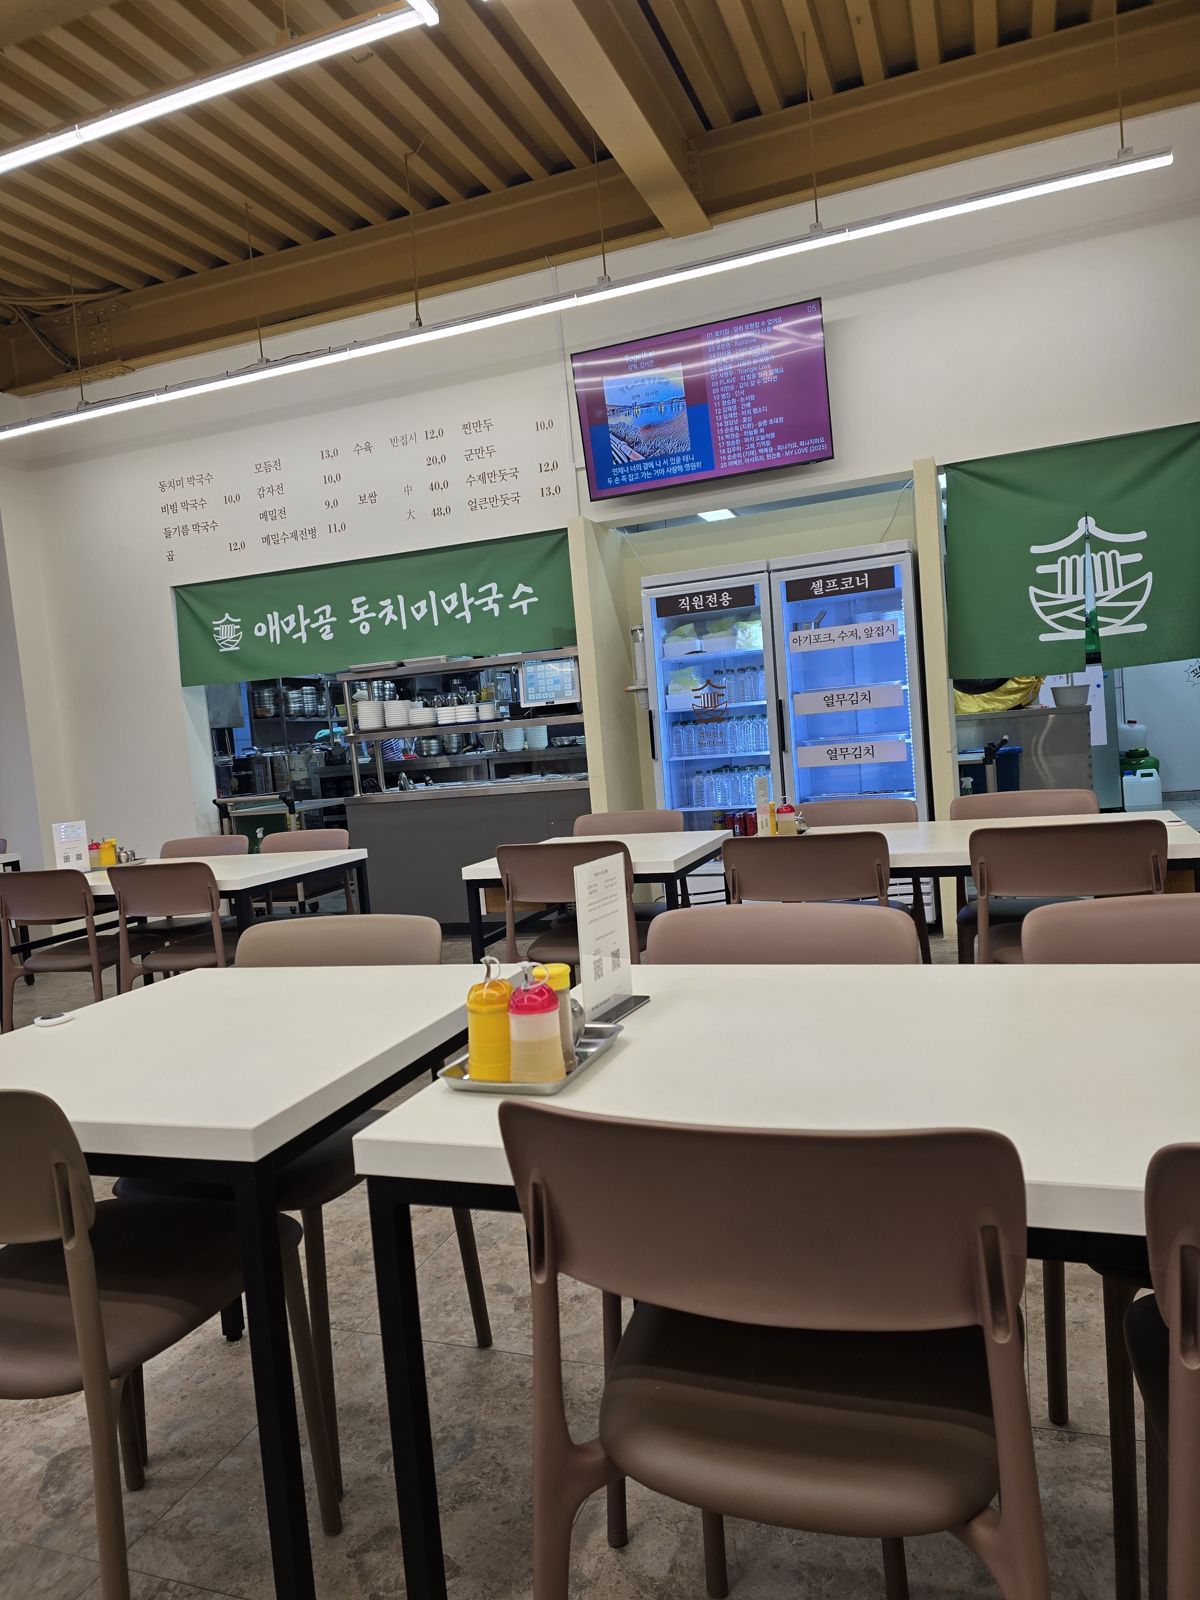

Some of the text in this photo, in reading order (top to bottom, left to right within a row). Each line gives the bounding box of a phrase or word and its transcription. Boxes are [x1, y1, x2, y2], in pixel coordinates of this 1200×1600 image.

[738, 366, 757, 375] Triangle
[720, 377, 736, 386] PLAVE
[462, 419, 493, 435] 찐만두
[353, 441, 373, 455] 수육
[390, 432, 417, 447] 반접시
[795, 447, 808, 455] LOVE
[810, 444, 826, 452] (2025)
[464, 445, 496, 461] 군만두
[254, 458, 282, 474] 모듬전
[612, 466, 628, 475] 언제나
[630, 464, 641, 472] 너의
[643, 461, 654, 470] 곁에
[670, 456, 681, 465] 있을
[158, 472, 213, 492] 동치미 막국수
[466, 467, 520, 487] 수제만둣국
[614, 476, 620, 484] 손
[628, 473, 639, 482] 잡고
[641, 471, 652, 479] 가는
[653, 468, 664, 477] 거야
[257, 483, 285, 499] 감자전
[358, 491, 378, 504] 보쌈
[404, 484, 413, 496] 中
[161, 500, 178, 515] 비빔
[180, 497, 208, 512] 막국수
[467, 492, 521, 511] 얼큰만둣국
[259, 507, 287, 522] 메밀전
[406, 509, 416, 521] 大
[163, 520, 219, 539] 들기름 막국수
[261, 526, 317, 546] 메밀수제전병
[166, 551, 175, 562] 곱
[810, 573, 870, 595] 셀프코너
[677, 590, 733, 611] 직원전용
[254, 603, 337, 645] 애막골
[792, 622, 896, 647] 아기포크, 수저, 앞접시
[823, 690, 872, 707] 열무김치
[826, 744, 875, 761] 열무김치
